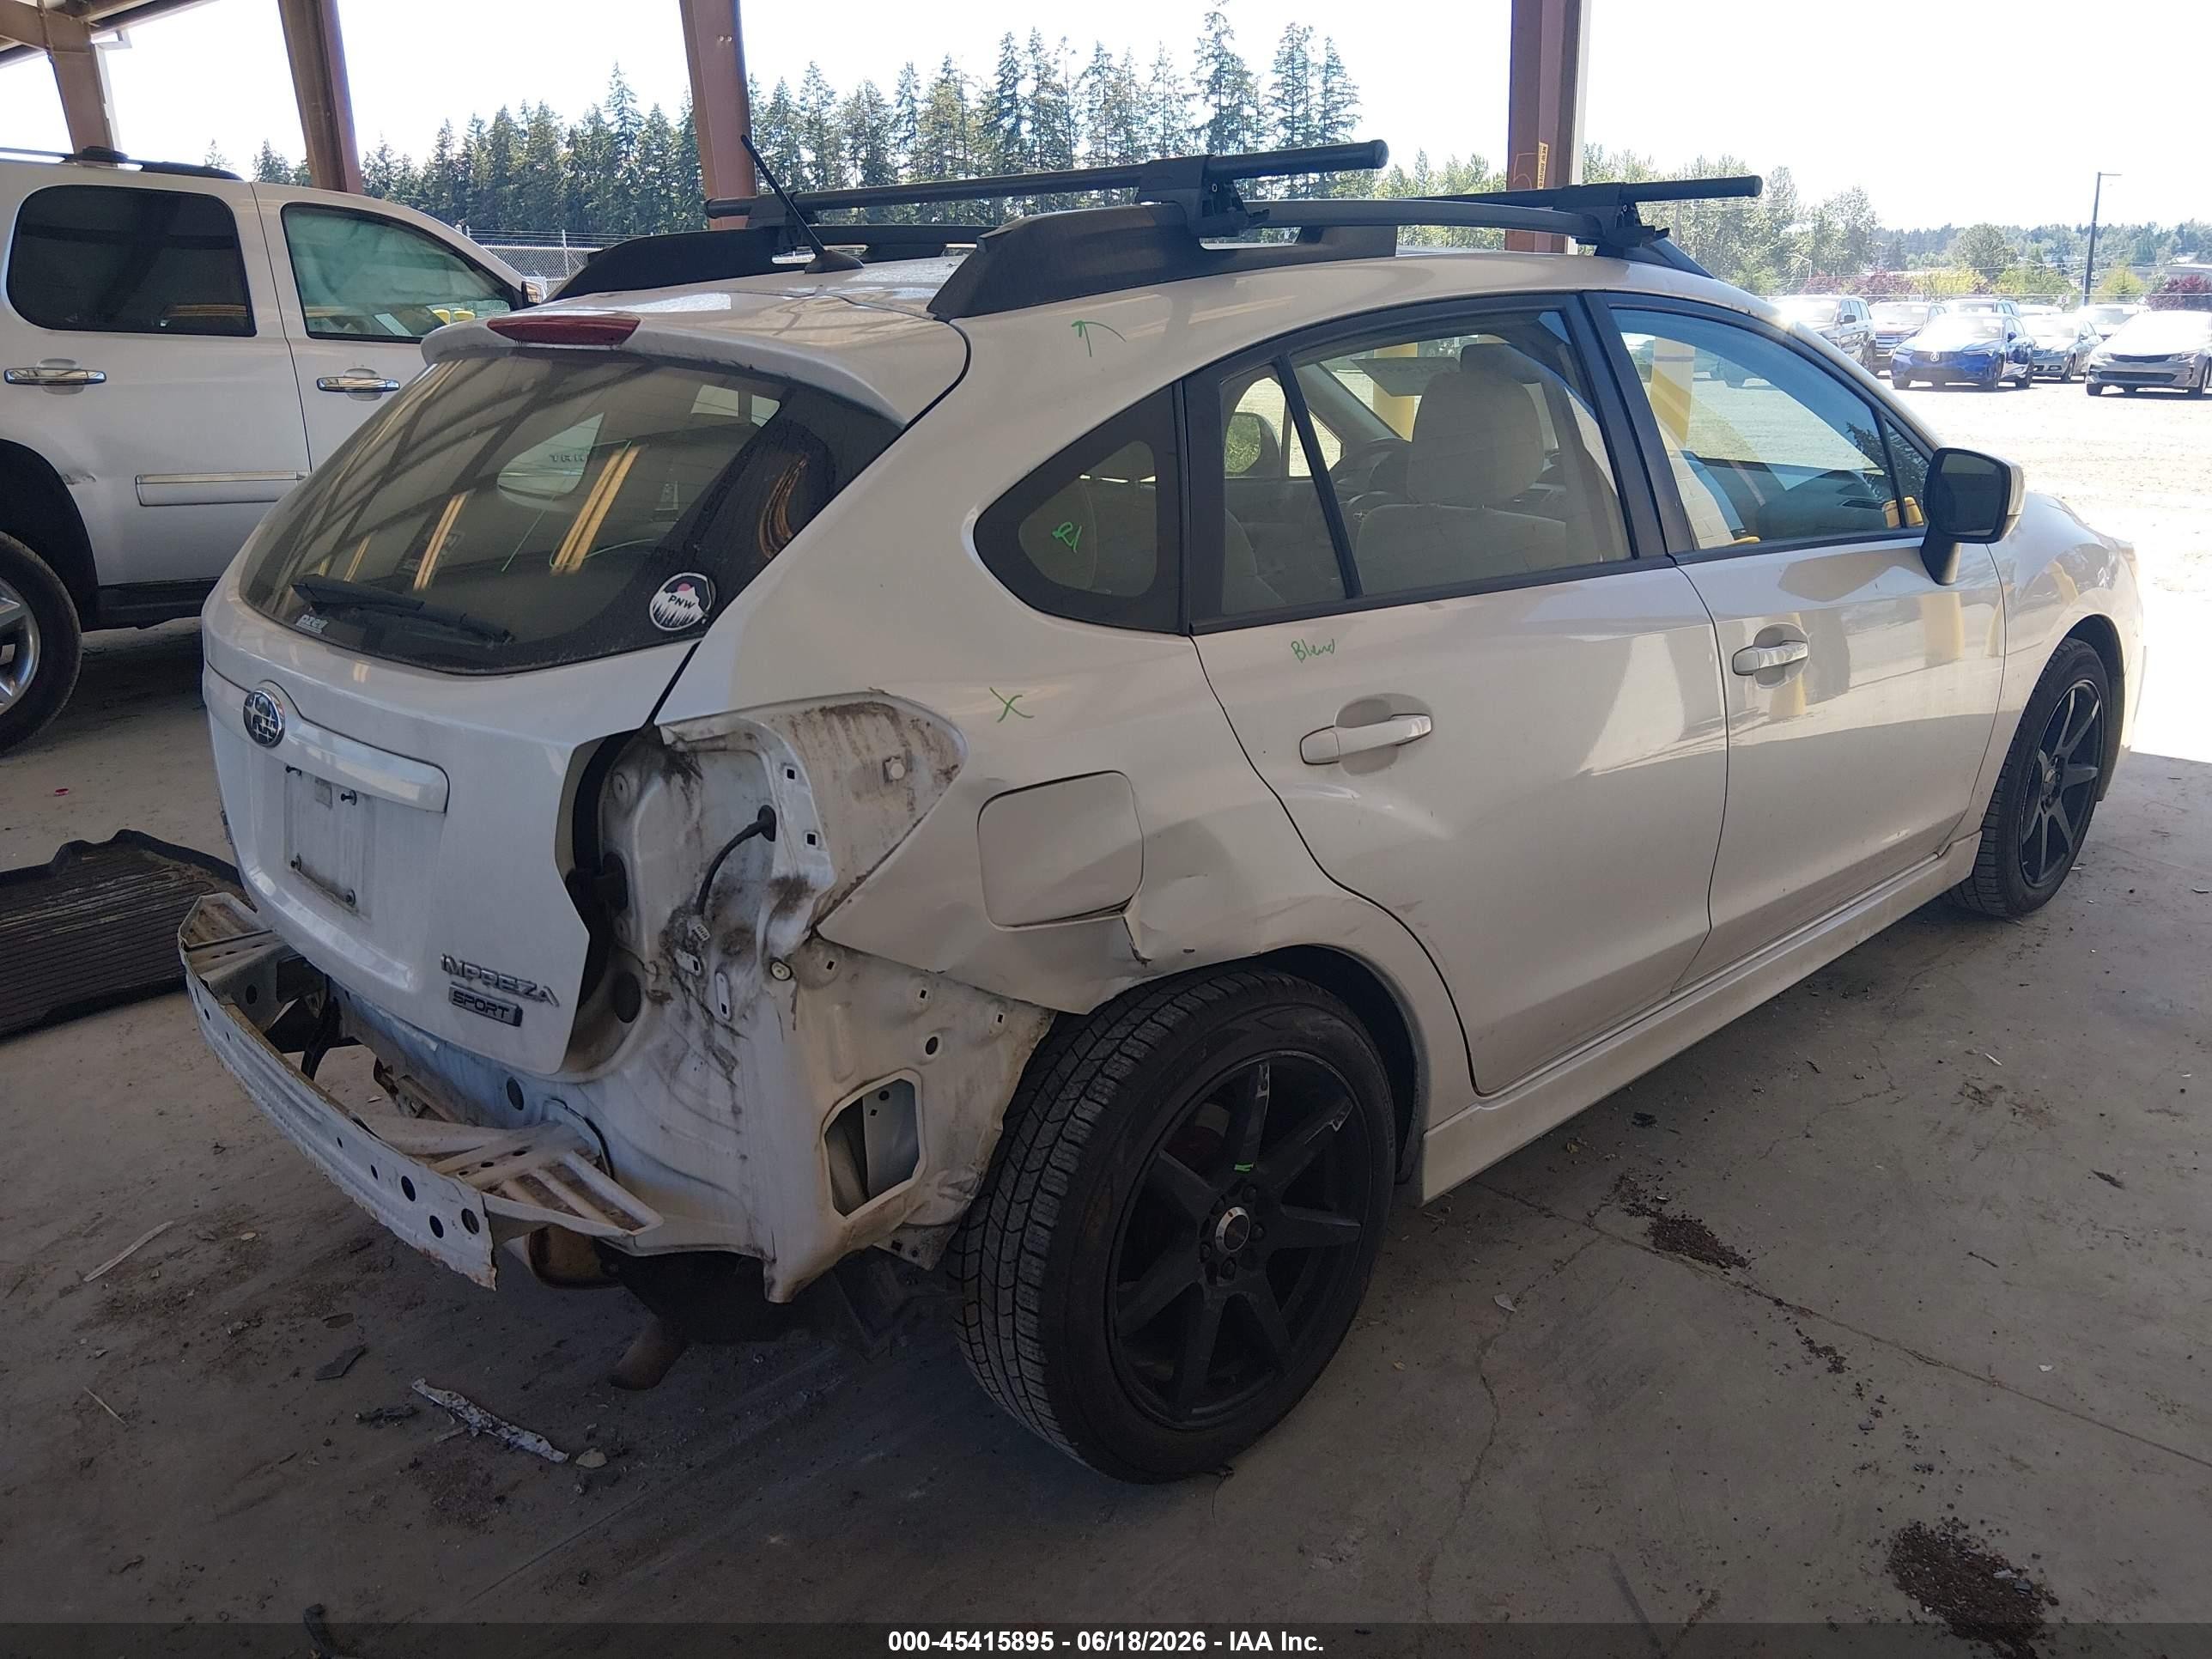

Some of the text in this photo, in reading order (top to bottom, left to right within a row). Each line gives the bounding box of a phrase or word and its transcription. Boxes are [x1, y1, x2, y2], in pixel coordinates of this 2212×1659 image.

[2061, 295, 2067, 304] 6
[667, 593, 696, 610] PNW
[441, 953, 559, 1007] IMPREZA
[453, 990, 510, 1019] SPORT
